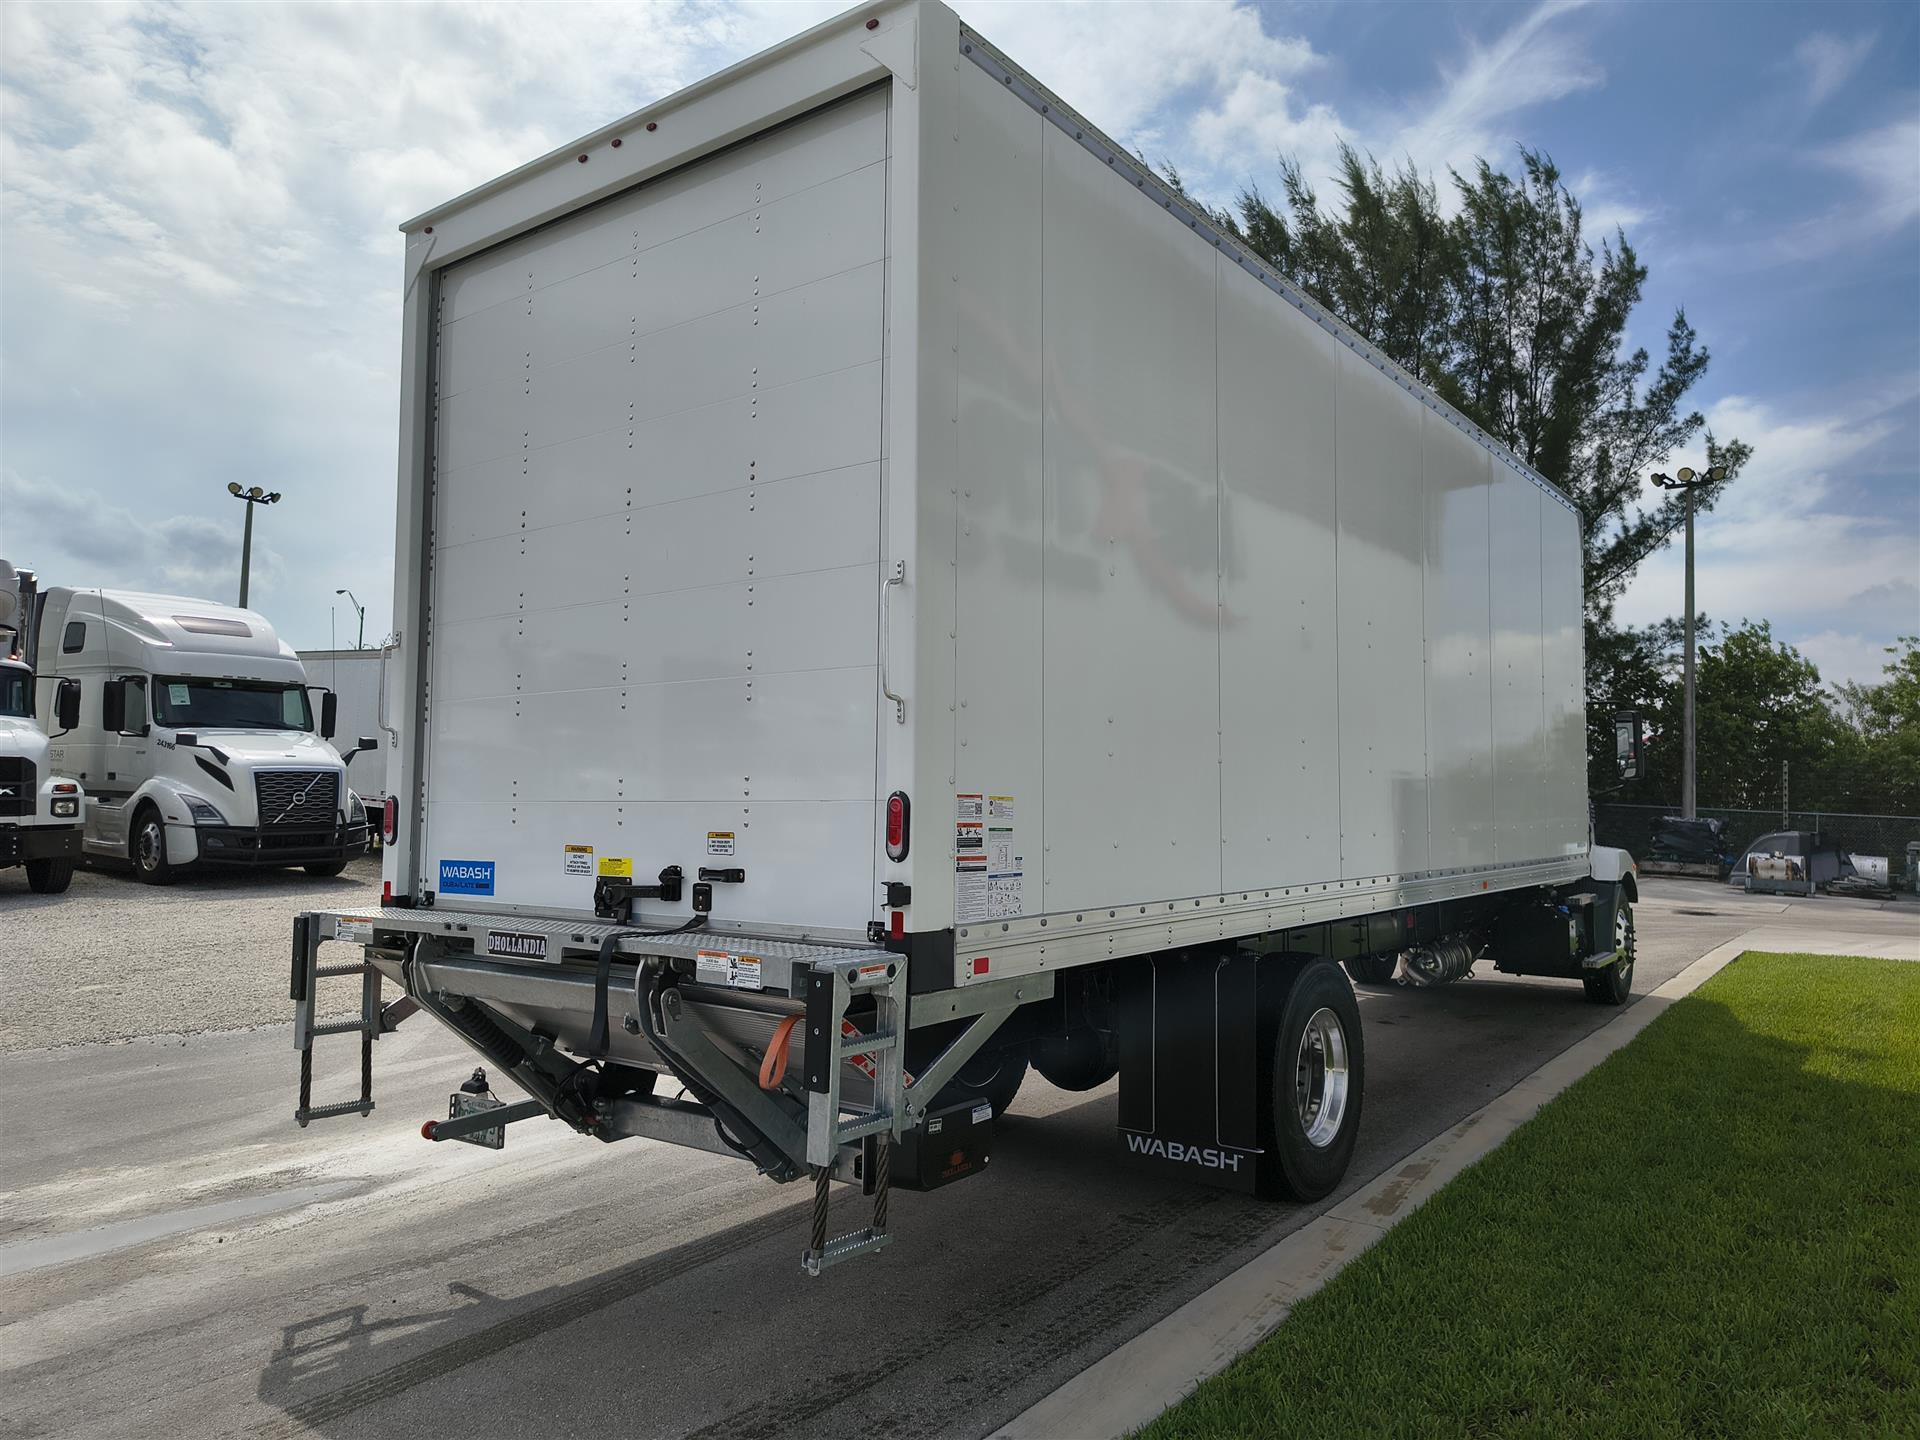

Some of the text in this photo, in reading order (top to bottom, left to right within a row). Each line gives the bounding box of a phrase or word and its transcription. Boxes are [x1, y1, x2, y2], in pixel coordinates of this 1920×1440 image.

[442, 866, 491, 879] WABASH
[488, 935, 546, 955] DHOLLANDIA
[1127, 1134, 1239, 1171] WABASH
